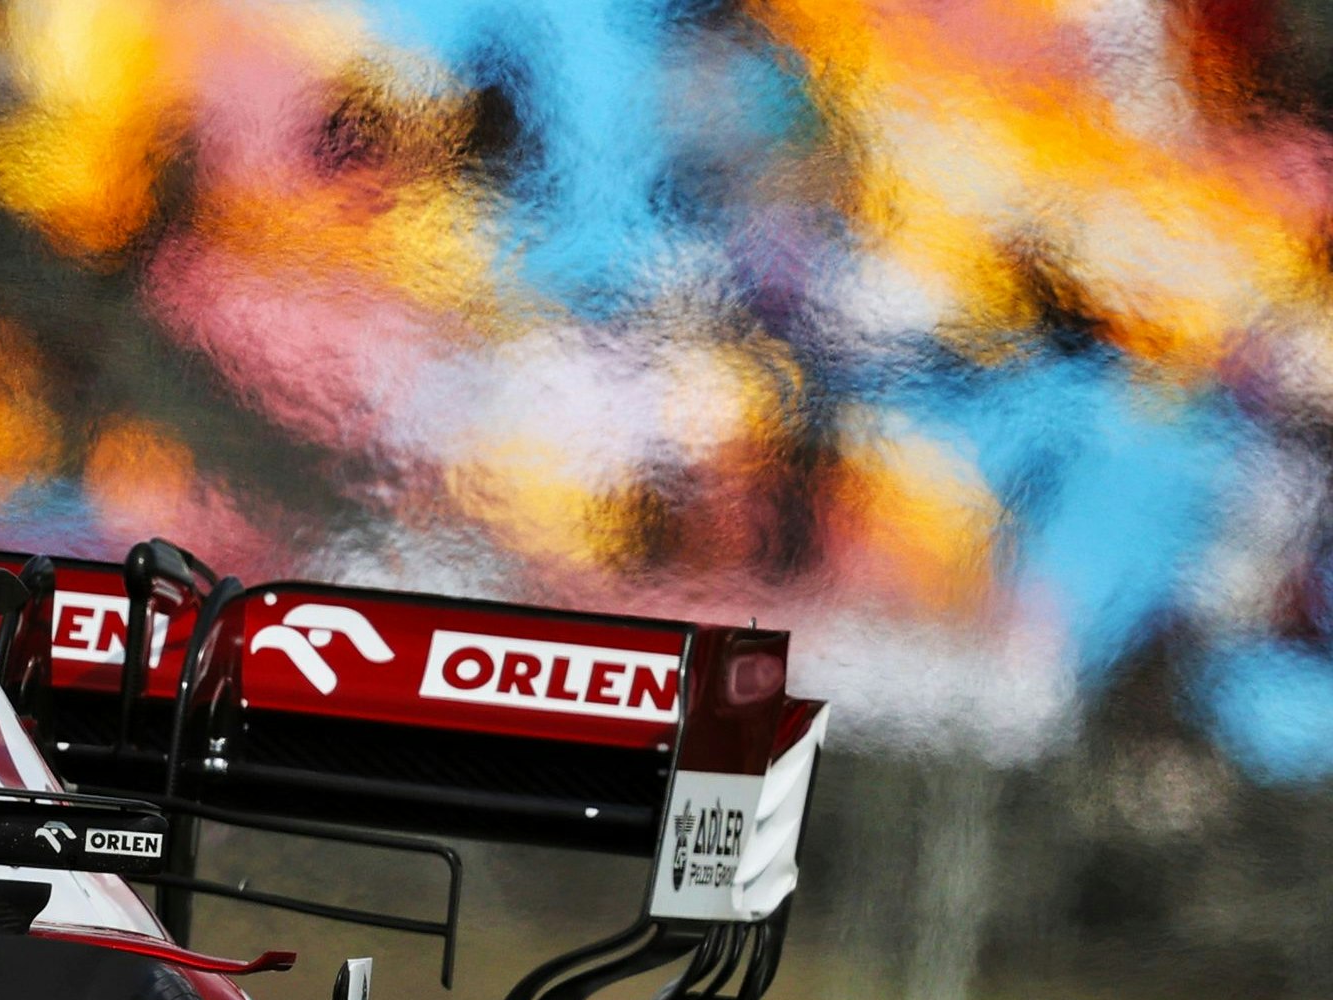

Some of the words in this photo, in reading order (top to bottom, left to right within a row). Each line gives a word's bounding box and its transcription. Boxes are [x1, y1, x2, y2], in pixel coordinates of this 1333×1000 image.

[441, 646, 679, 711] ORLEN
[90, 832, 158, 853] ORLEN
[692, 807, 743, 858] ADLER
